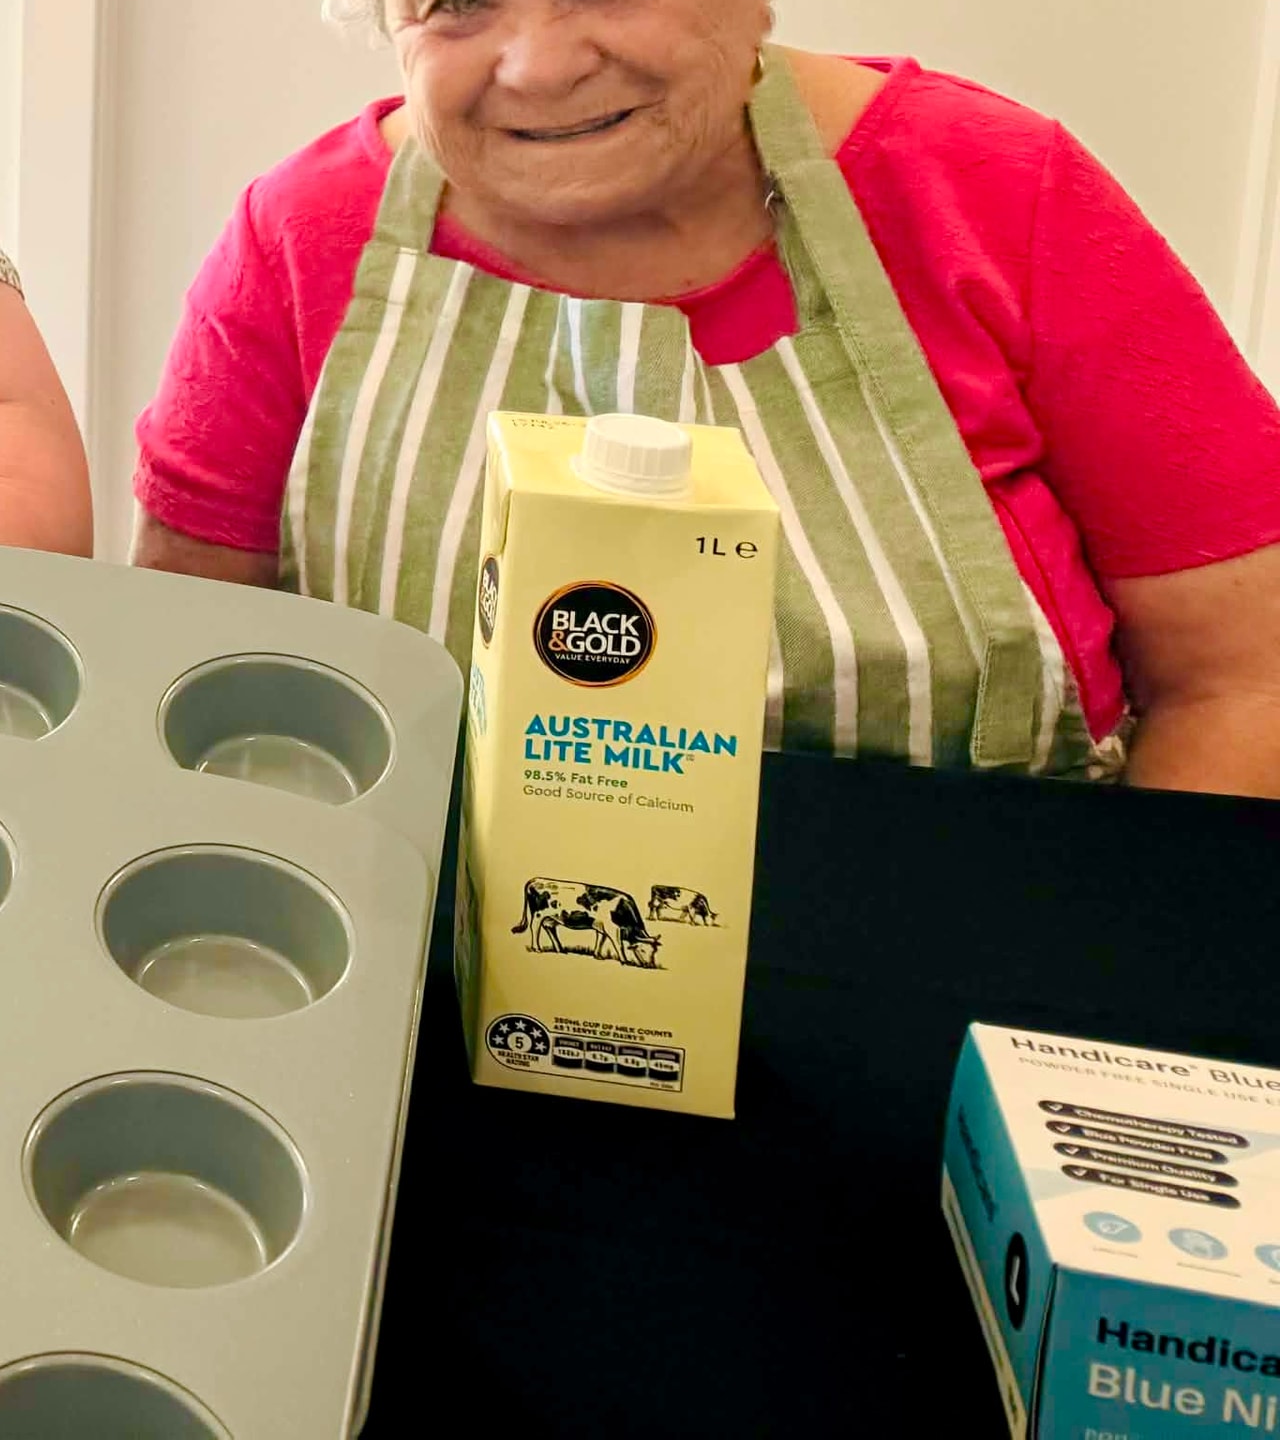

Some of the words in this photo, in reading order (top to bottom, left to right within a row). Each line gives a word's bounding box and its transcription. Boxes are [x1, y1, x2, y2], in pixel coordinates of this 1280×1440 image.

[552, 610, 641, 637] BLACK
[548, 630, 641, 657] &GOLD
[555, 653, 582, 661] VALUE
[585, 655, 631, 665] EVERYDAY
[525, 714, 737, 757] AUSTRALIAN
[525, 738, 592, 764] LITE
[604, 744, 685, 774] MILK
[524, 769, 567, 783] 98.5%
[571, 772, 593, 785] Fat
[597, 776, 628, 789] Free
[523, 784, 561, 798] Good
[566, 788, 614, 803] Source
[618, 793, 634, 806] of
[635, 795, 694, 813] Calcium
[515, 1036, 524, 1049] 5
[1010, 1036, 1192, 1077] Handicare
[1209, 1068, 1280, 1092] Blue
[1018, 1056, 1096, 1076] POWDER
[1073, 1108, 1185, 1136] Chemotherapy
[1185, 1128, 1239, 1146] Tested
[1118, 1134, 1176, 1154] Powder
[1177, 1146, 1213, 1160] Free
[1090, 1150, 1160, 1171] Premium
[1161, 1161, 1218, 1183] Quality
[1098, 1173, 1126, 1186] For
[1129, 1178, 1178, 1196] Single
[1180, 1188, 1211, 1202] Use
[1087, 1362, 1207, 1416] Blue
